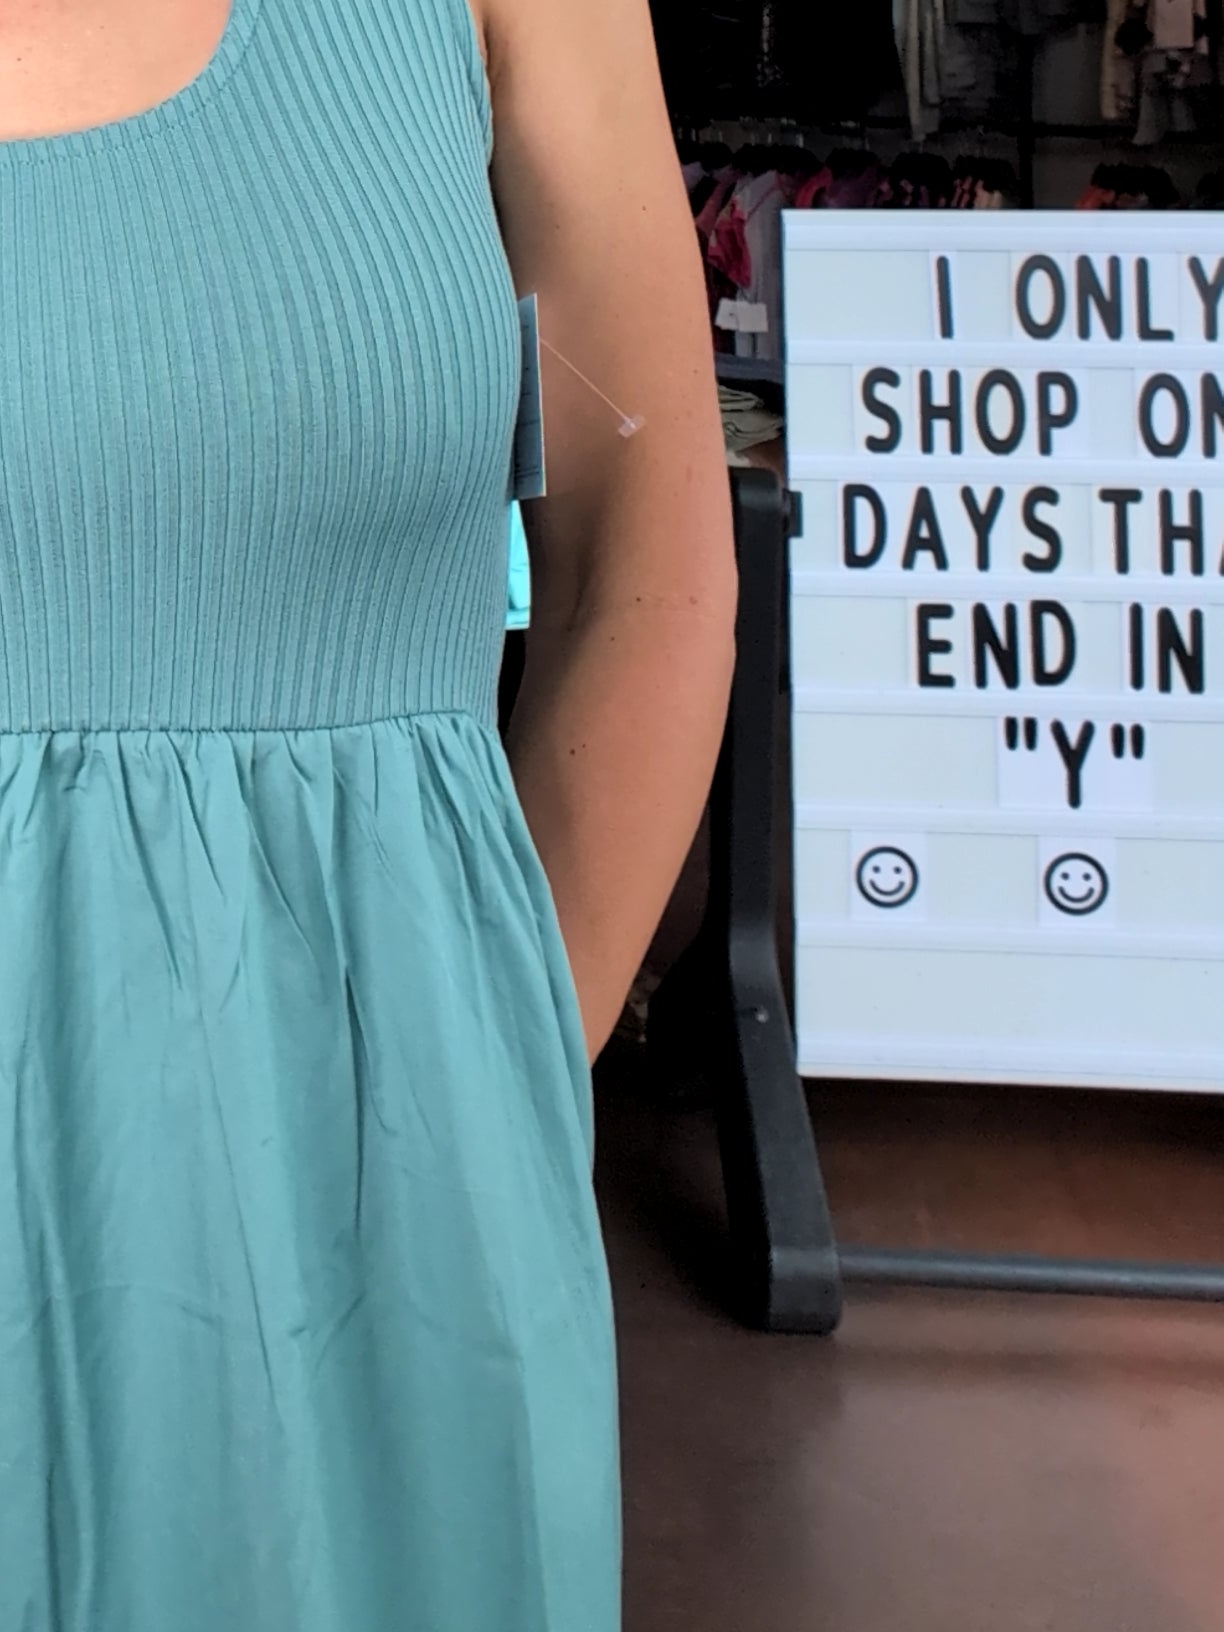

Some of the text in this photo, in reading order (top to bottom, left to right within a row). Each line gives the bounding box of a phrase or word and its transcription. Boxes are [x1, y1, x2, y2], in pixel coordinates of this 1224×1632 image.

[935, 253, 1224, 342] I ONLY
[861, 366, 1078, 456] SHOP
[841, 482, 1224, 577] DAYS TH
[915, 599, 1205, 695] END IN
[1003, 715, 1146, 809] "Y"
